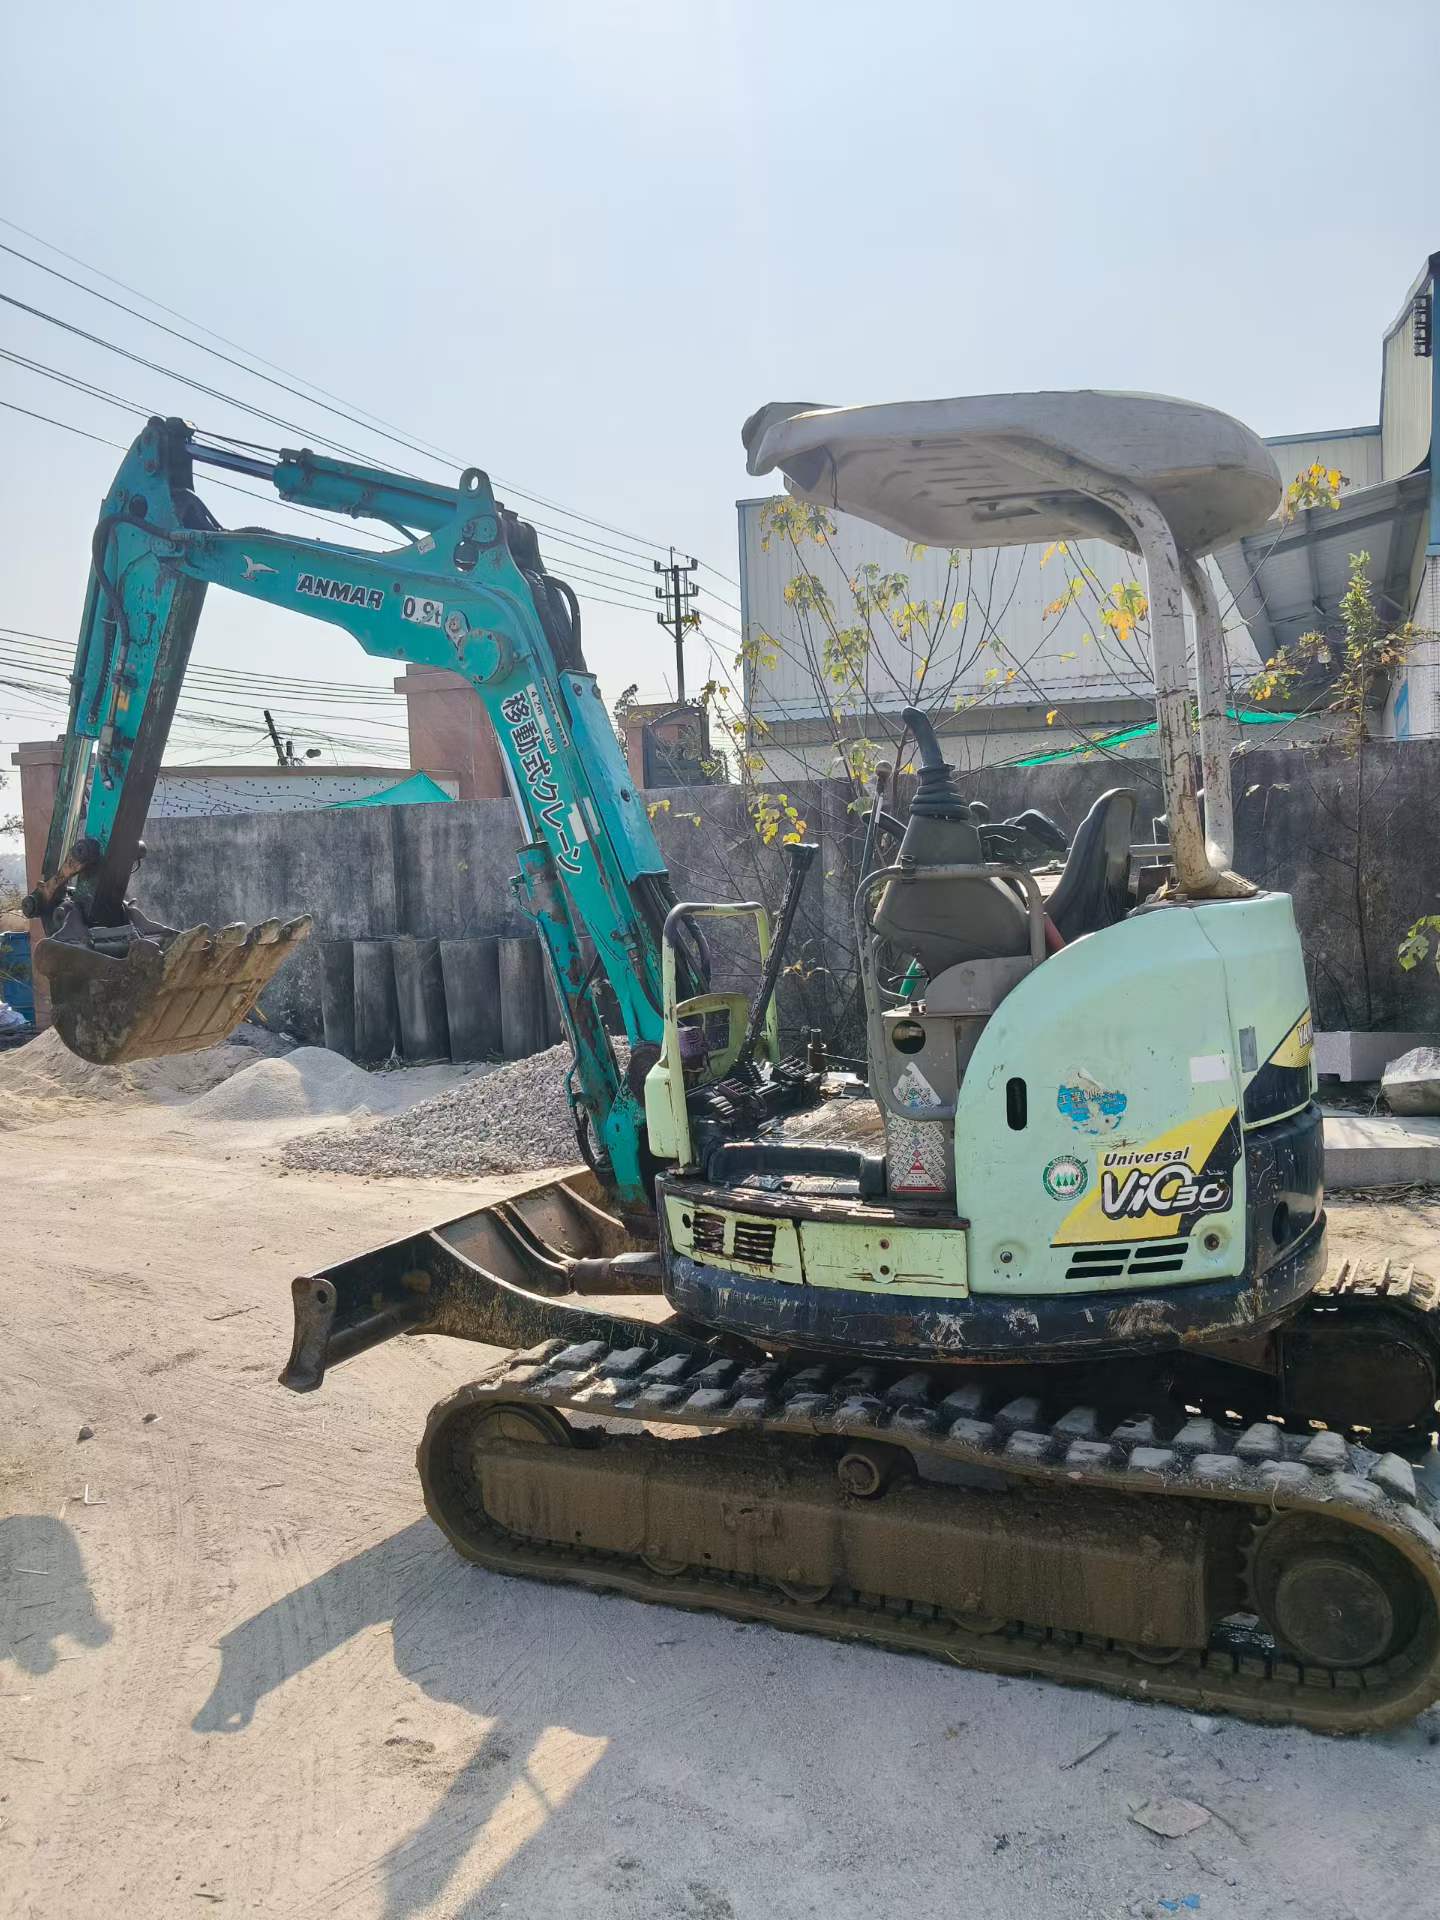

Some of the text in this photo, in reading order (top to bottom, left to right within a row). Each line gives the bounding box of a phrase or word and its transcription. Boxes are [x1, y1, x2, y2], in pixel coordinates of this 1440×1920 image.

[501, 690, 583, 874] 移動式クレーン
[1103, 1146, 1190, 1167] Universal
